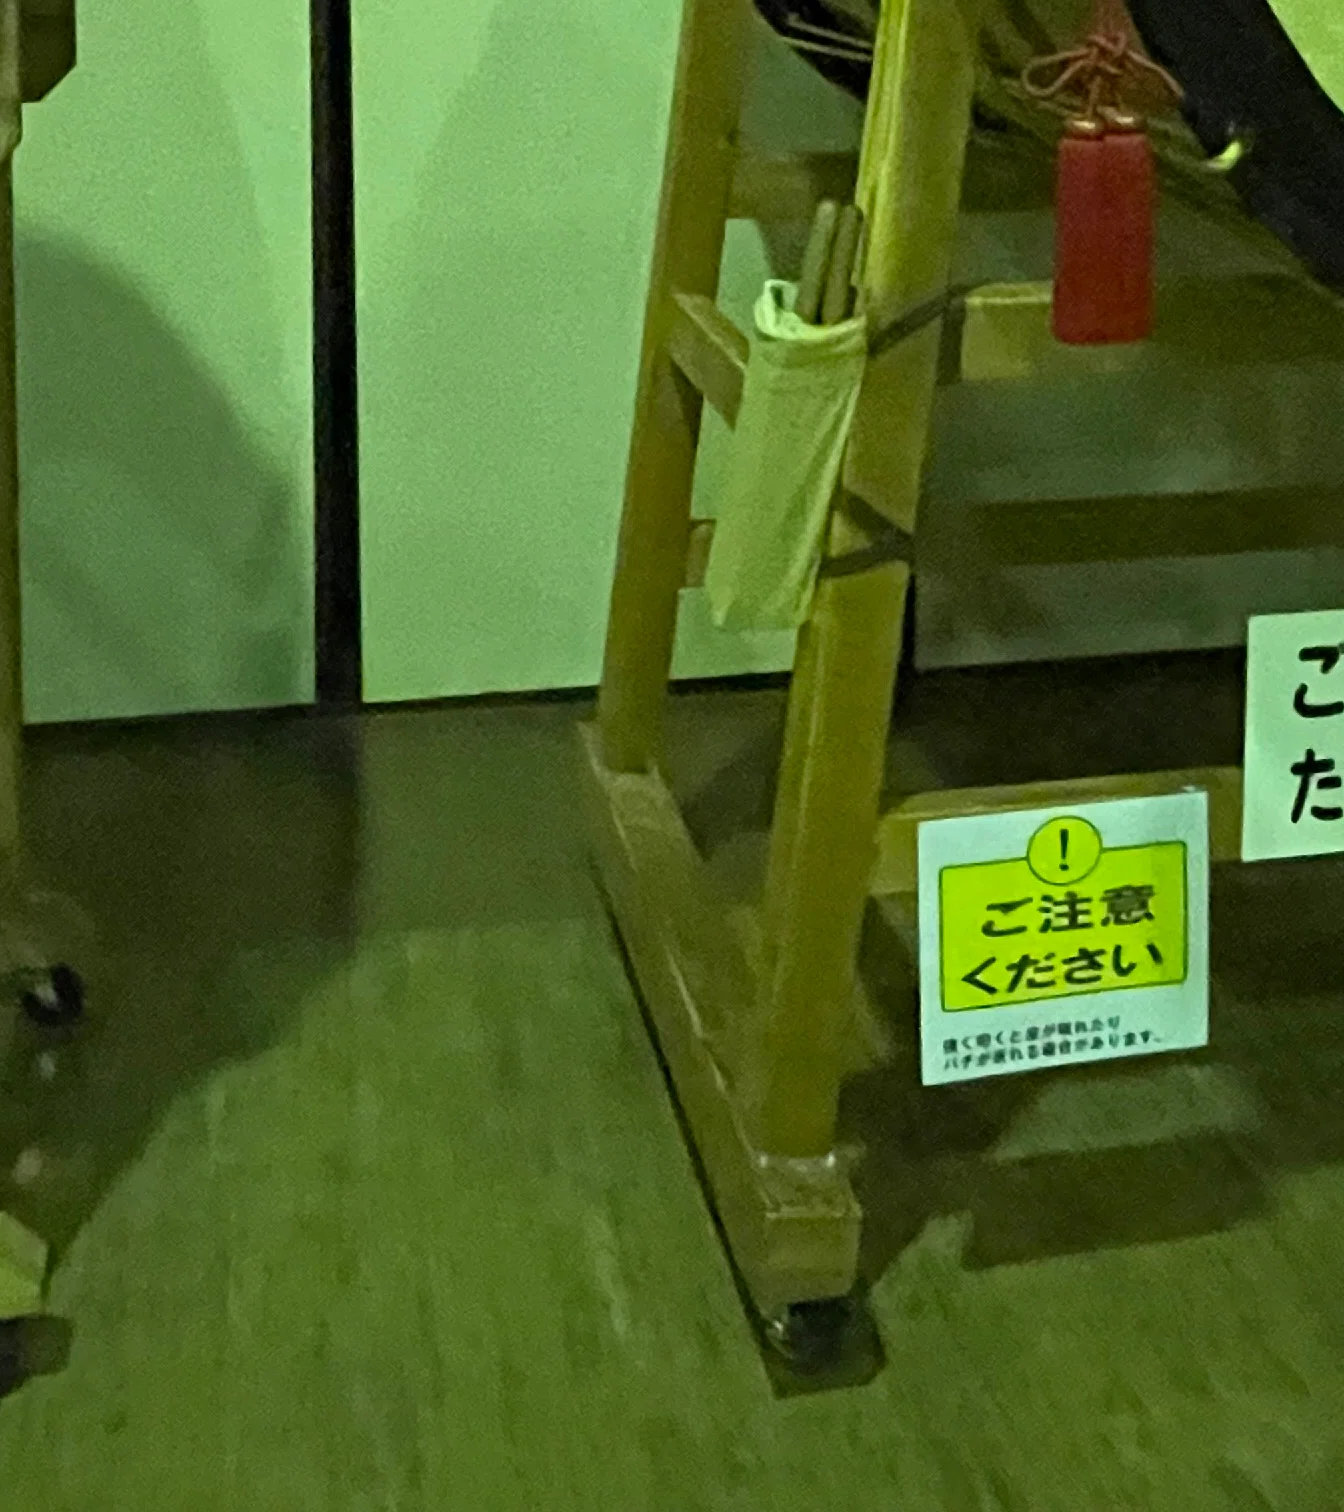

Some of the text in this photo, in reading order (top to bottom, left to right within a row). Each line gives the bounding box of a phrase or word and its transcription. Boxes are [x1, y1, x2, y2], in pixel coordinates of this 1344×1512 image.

[981, 884, 1157, 938] ご注意
[960, 942, 1164, 995] ください
